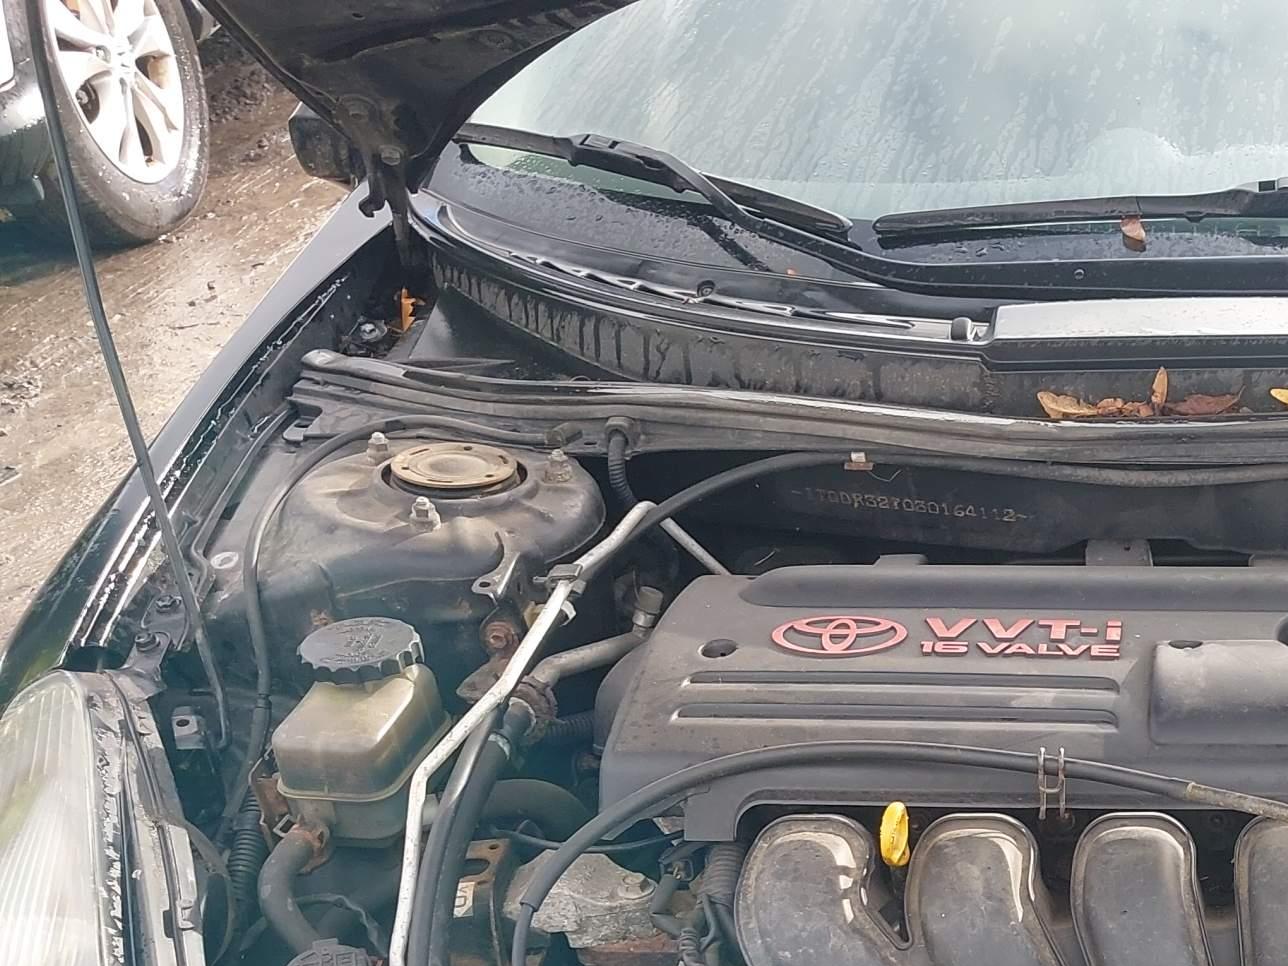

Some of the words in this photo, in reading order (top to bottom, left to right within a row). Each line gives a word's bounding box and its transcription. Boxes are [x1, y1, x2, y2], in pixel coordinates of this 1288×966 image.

[925, 617, 1122, 644] VVT-i
[920, 641, 968, 657] 16
[976, 642, 1121, 660] VALVE
